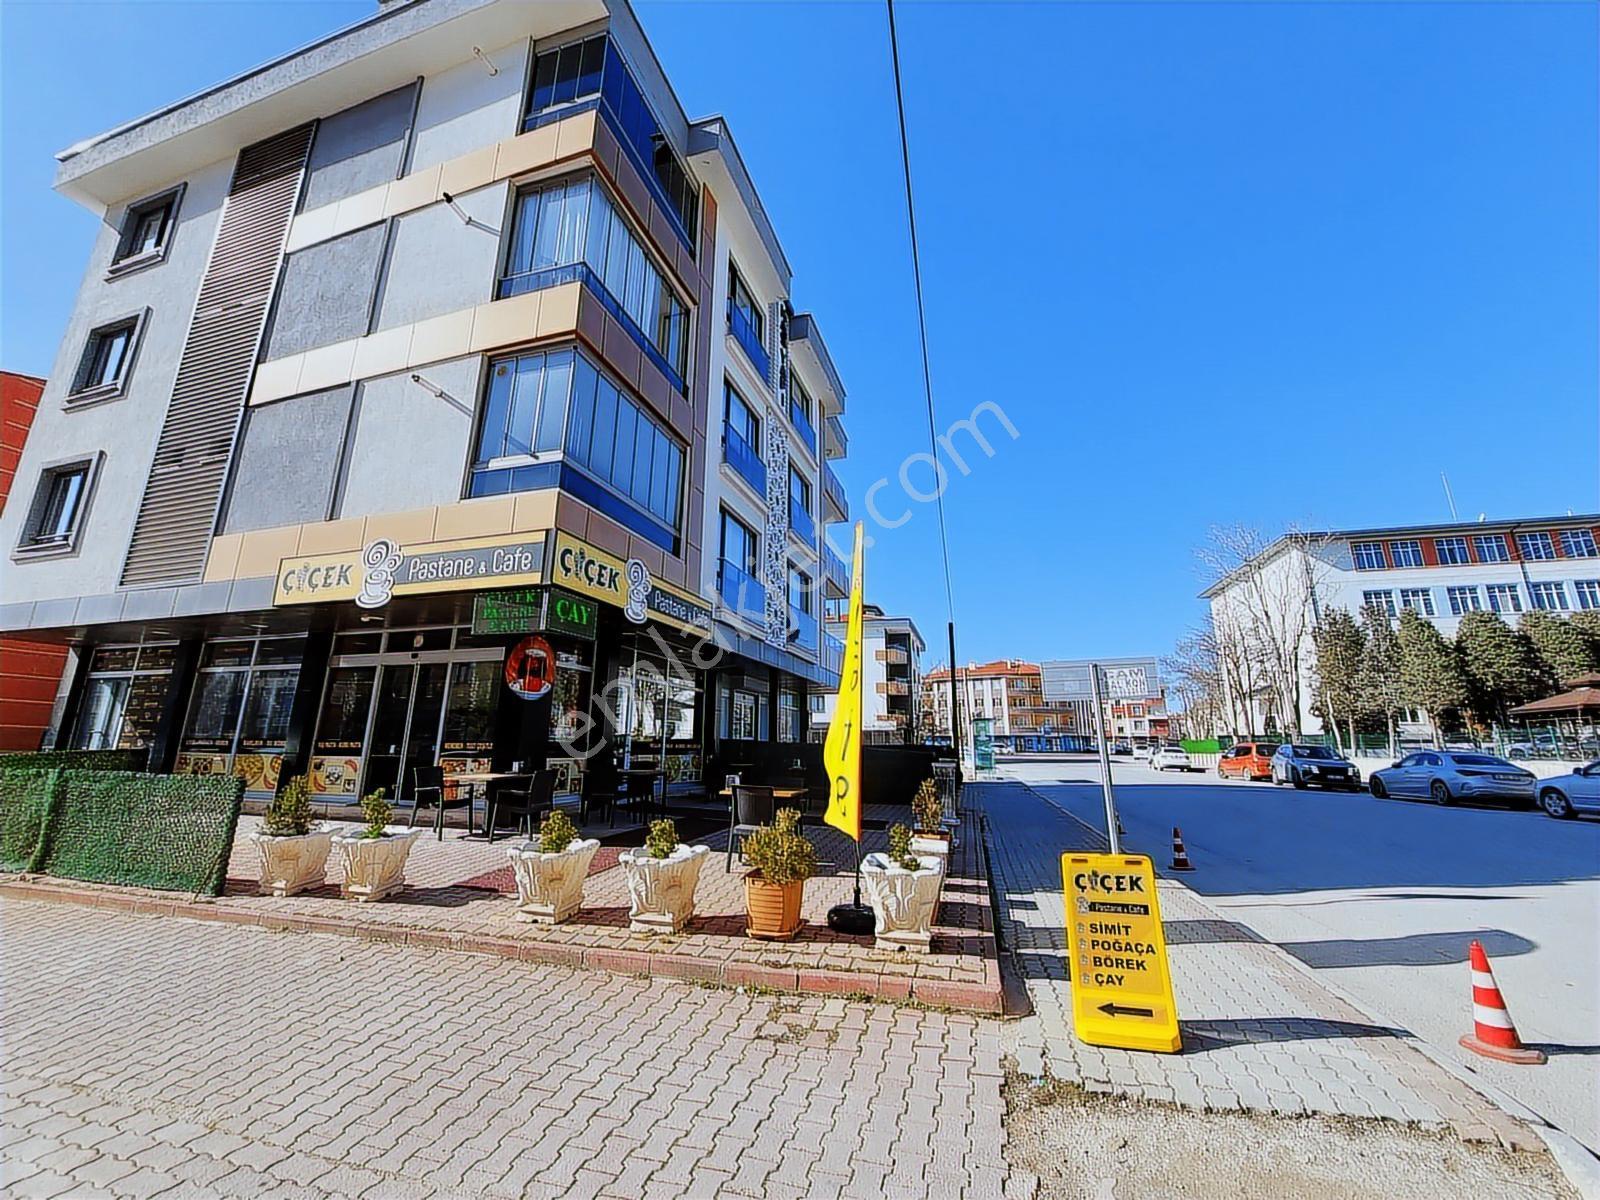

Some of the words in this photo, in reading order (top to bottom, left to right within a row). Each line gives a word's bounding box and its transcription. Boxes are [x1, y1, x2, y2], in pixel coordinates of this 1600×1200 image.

[408, 557, 474, 582] Pastane
[478, 561, 487, 574] &
[492, 549, 532, 573] Cafe
[555, 598, 591, 625] ÇAY
[654, 589, 686, 620] Pastane
[1074, 870, 1144, 894] ÇİÇEK
[1095, 902, 1122, 913] Pastane
[1128, 905, 1145, 914] Cafe
[1089, 921, 1131, 936] SİMİT
[1091, 939, 1156, 956] POĞAÇA
[1093, 955, 1147, 971] BÖREK
[1094, 973, 1124, 987] ÇAY
